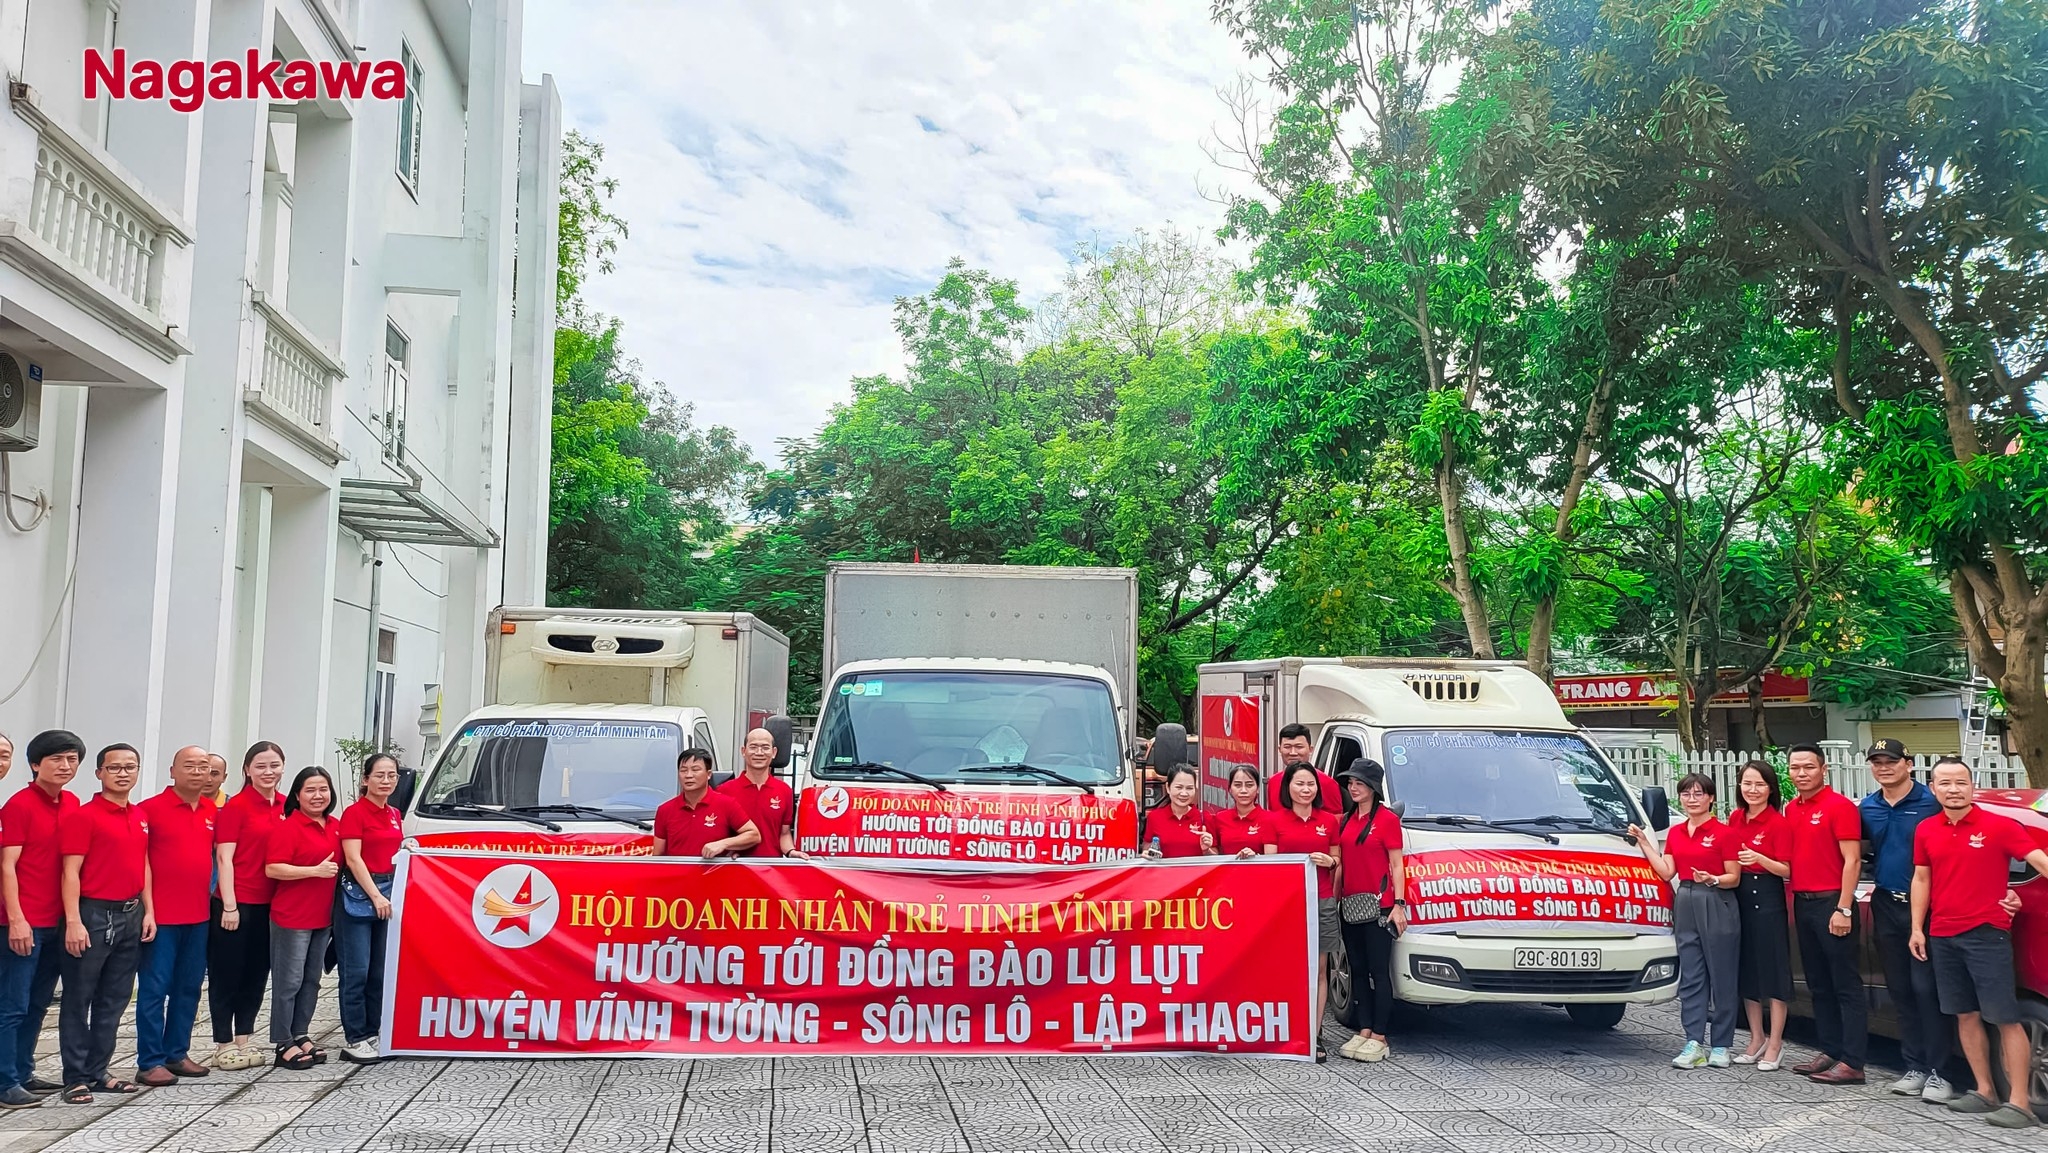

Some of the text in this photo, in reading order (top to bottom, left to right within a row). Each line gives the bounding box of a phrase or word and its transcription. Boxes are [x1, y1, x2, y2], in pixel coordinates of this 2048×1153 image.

[1560, 682, 1631, 699] TRANG
[473, 725, 496, 737] CTY
[610, 726, 640, 738] MINH
[643, 725, 667, 739] TÂM
[1403, 736, 1422, 747] CTY
[853, 797, 877, 813] HỘI
[881, 798, 930, 812] DOANH
[934, 799, 975, 815] NHÂN
[861, 812, 1105, 843] HƯỚNG TỚI ĐỒNG BÀO LŨ LỤT
[800, 833, 850, 856] HUYỆN
[854, 833, 892, 853] VĨNH
[896, 835, 950, 856] TƯỜNG
[966, 838, 1011, 858] SÔNG
[1016, 839, 1036, 859] LÔ
[1052, 841, 1082, 865] LẬP
[1405, 863, 1432, 880] HỘI
[1436, 860, 1487, 877] DOANH
[1490, 859, 1530, 875] NHÂN
[1597, 862, 1632, 879] VĨNH
[1419, 872, 1659, 903] HƯỚNG TỚI ĐỒNG BÀO LŨ LỤT
[569, 887, 1234, 937] HỘI DOANH NHÂN TRẺ TỈNH VĨNH PHÚC
[1415, 901, 1457, 921] VĨNH
[1461, 898, 1517, 916] TƯỜNG
[1533, 897, 1577, 917] SÔNG
[1582, 901, 1601, 917] LÔ
[1615, 904, 1642, 924] LẬP
[595, 934, 1205, 995] HƯỚNG TỚI ĐỒNG BÀO LŨ LỤT
[418, 990, 1290, 1051] HUYỆN VĨNH TƯỜNG - SÔNG LÔ - LẬP THẠCH
